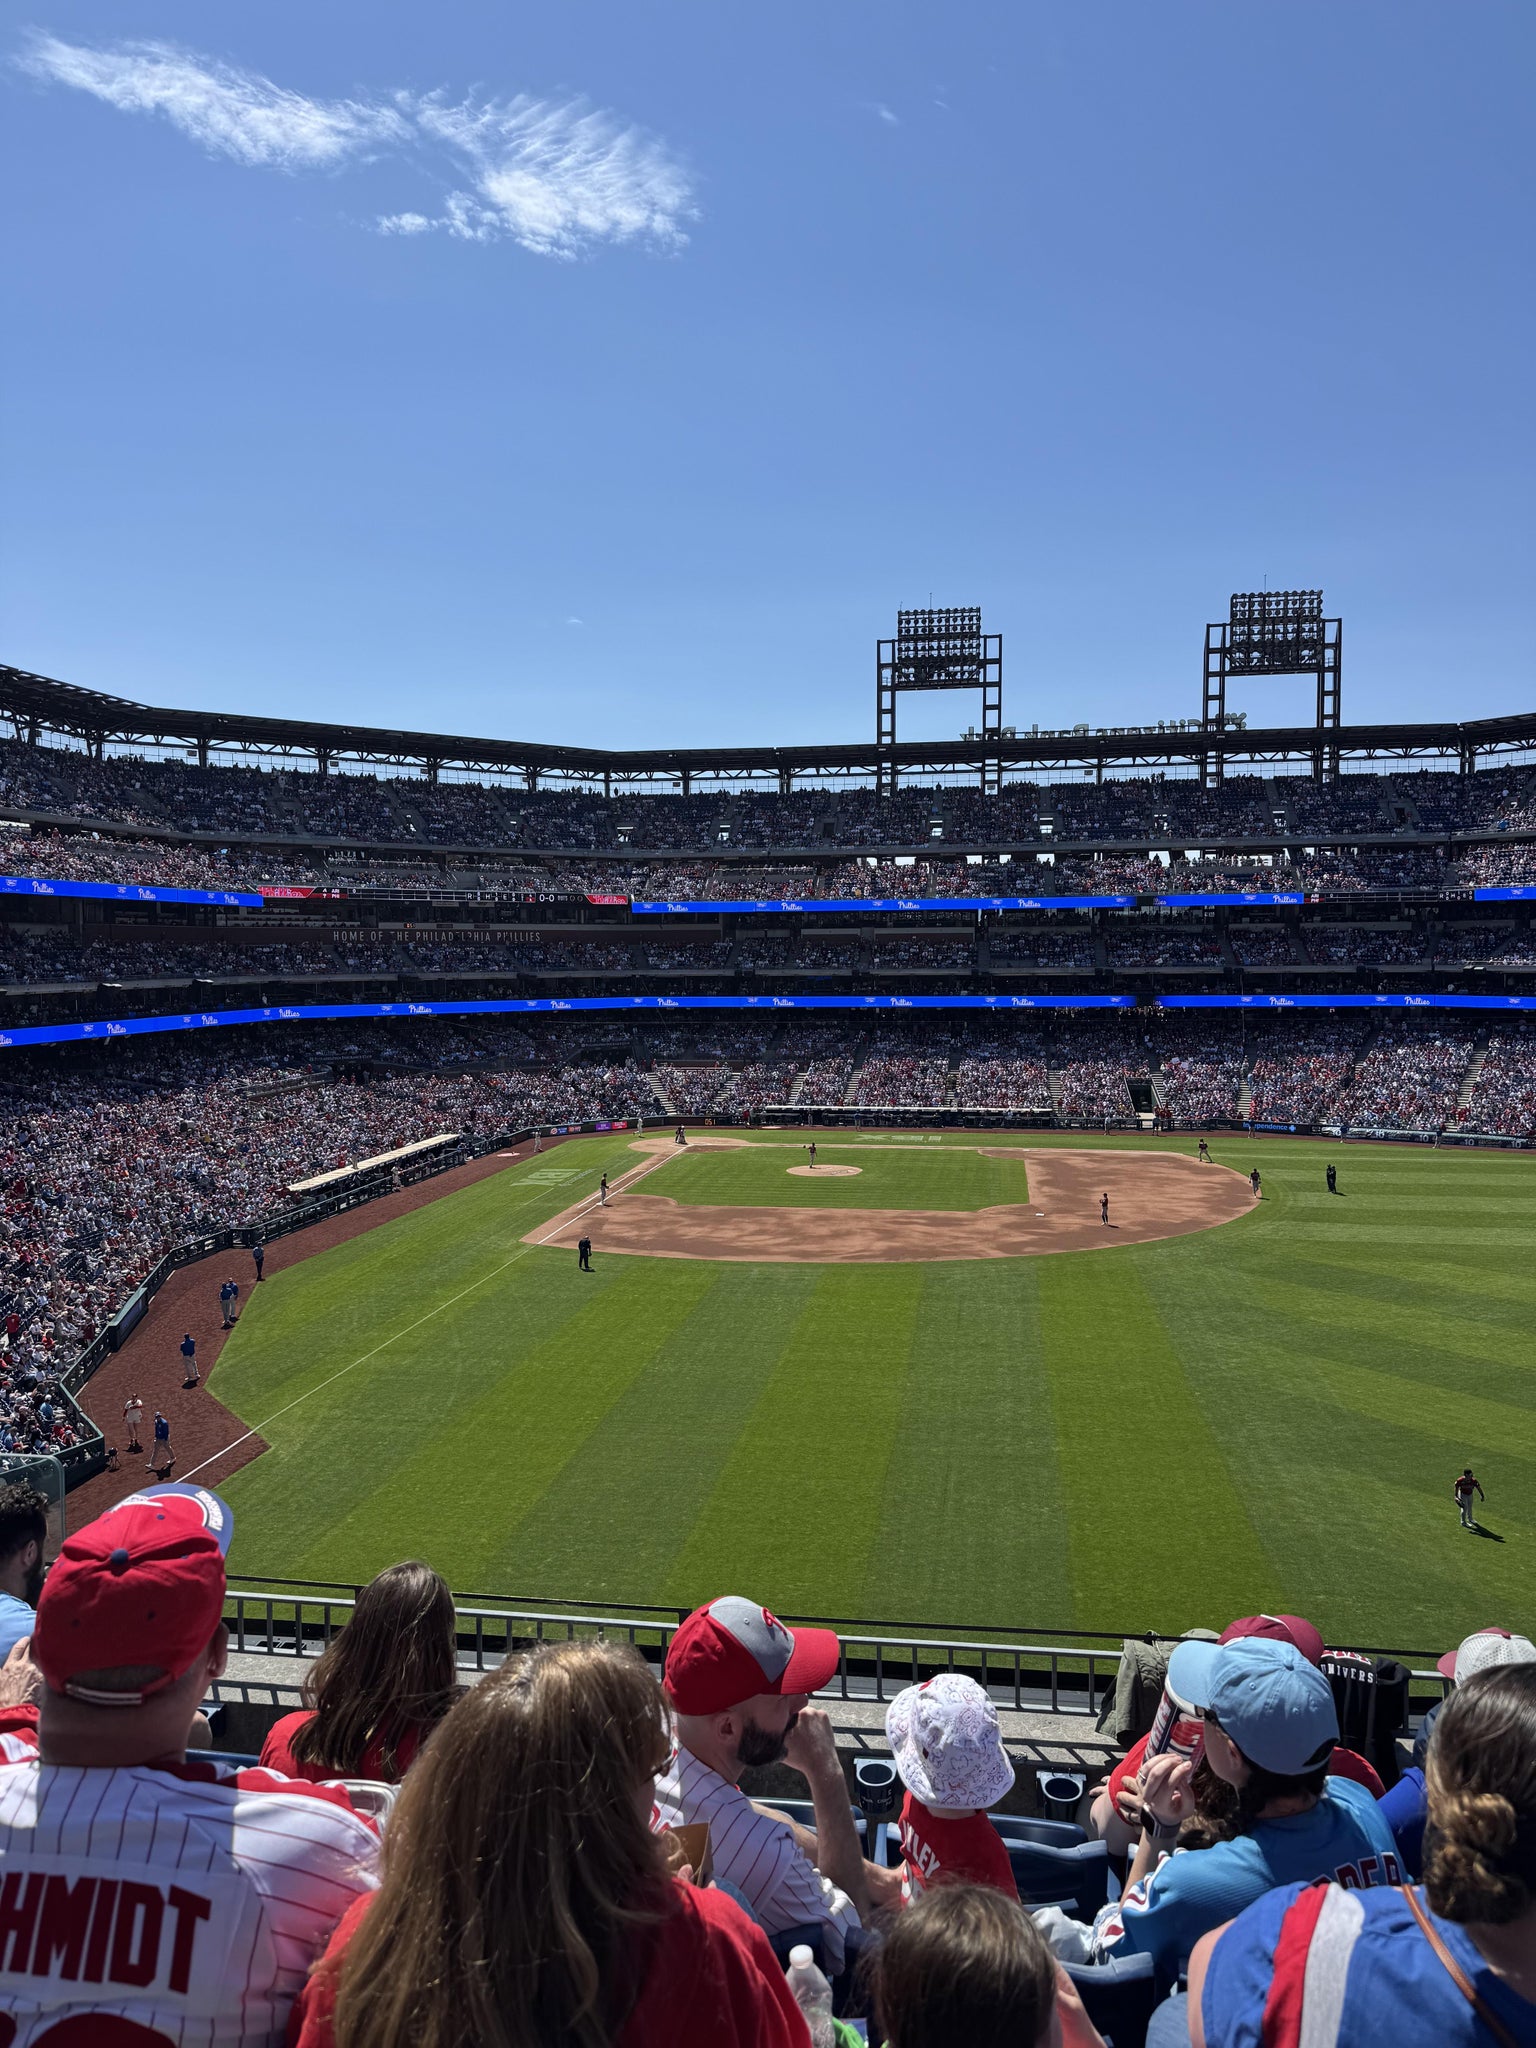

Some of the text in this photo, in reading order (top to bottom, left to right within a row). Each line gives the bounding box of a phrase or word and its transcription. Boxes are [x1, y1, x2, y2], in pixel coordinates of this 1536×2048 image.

[31, 880, 55, 894] Phillies
[137, 887, 157, 900] Phillies
[1017, 898, 1041, 908] Phillies
[1272, 894, 1298, 904] Phillies
[665, 902, 689, 912] Phillies
[781, 902, 803, 911] Phillies
[897, 901, 920, 910] Phillies
[333, 930, 364, 942] HOME
[370, 930, 384, 942] OF
[550, 1000, 572, 1009] Phillies
[657, 997, 679, 1007] Phillies
[772, 997, 795, 1007] Phillies
[890, 997, 913, 1007] Phillies
[1011, 996, 1035, 1006] Phillies
[1268, 996, 1295, 1006] Phillies
[1404, 995, 1431, 1006] Phillies
[278, 1008, 301, 1018] Phillies
[408, 1004, 433, 1014] Phillies
[106, 1022, 127, 1034] Phillies
[0, 1871, 212, 1995] HMIDT
